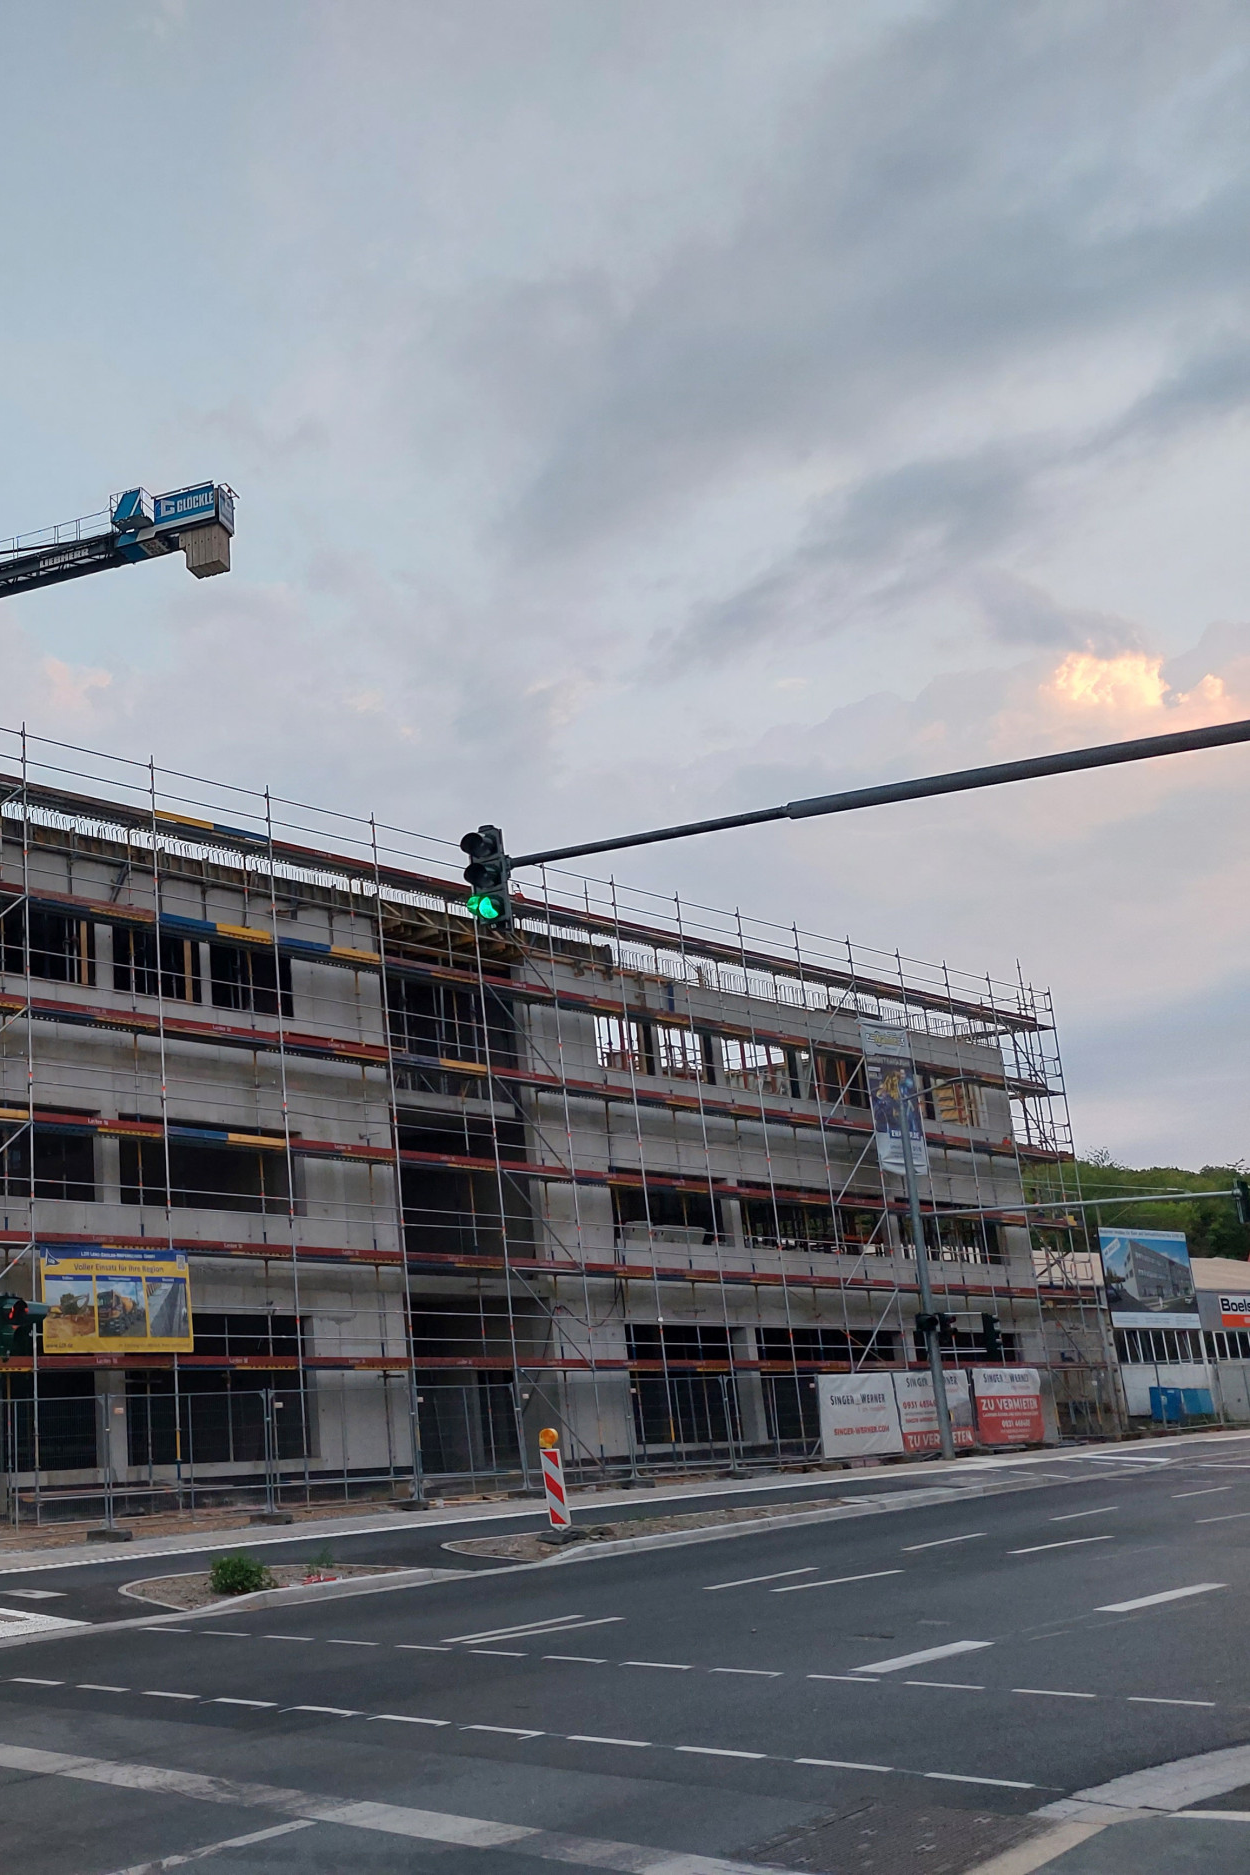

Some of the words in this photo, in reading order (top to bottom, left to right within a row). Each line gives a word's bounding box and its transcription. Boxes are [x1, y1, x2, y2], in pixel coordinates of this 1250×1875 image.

[40, 548, 89, 568] LIEBHERR
[74, 1263, 94, 1271] Voller
[142, 1265, 164, 1274] Region
[830, 1395, 854, 1406] SINGER
[859, 1393, 886, 1405] WERNER
[981, 1399, 994, 1411] ZU
[997, 1398, 1038, 1411] VERMIETEN
[908, 1435, 920, 1448] ZU
[922, 1430, 973, 1447] VERETEN
